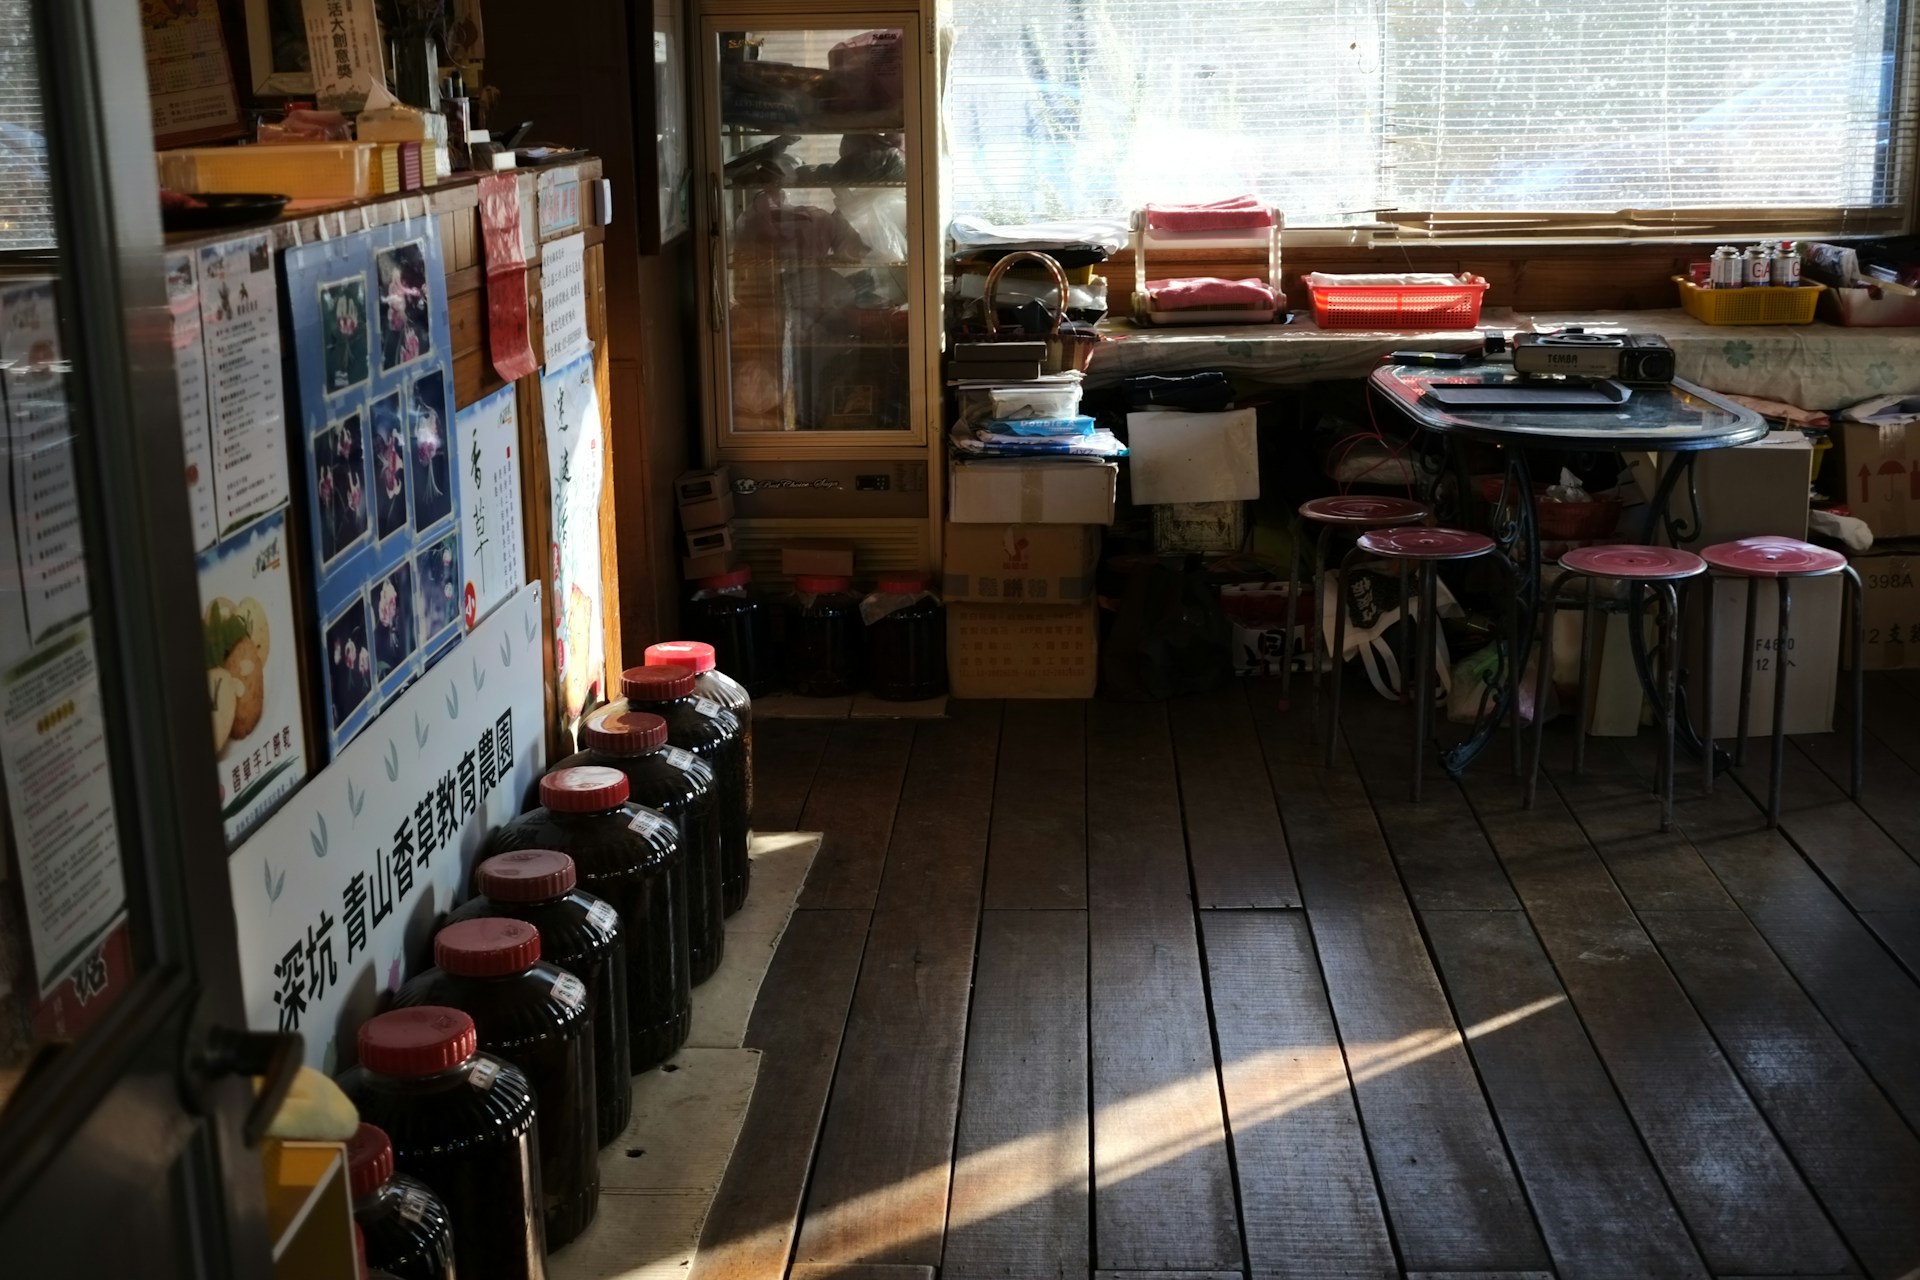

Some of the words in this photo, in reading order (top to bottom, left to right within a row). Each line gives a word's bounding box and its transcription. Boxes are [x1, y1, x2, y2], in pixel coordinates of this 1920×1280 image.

[326, 0, 353, 80] 活大創意獎
[1547, 354, 1578, 364] TEMBA
[470, 428, 489, 595] 香草
[1868, 573, 1914, 589] 398A
[231, 724, 292, 793] 香草手工餅乾
